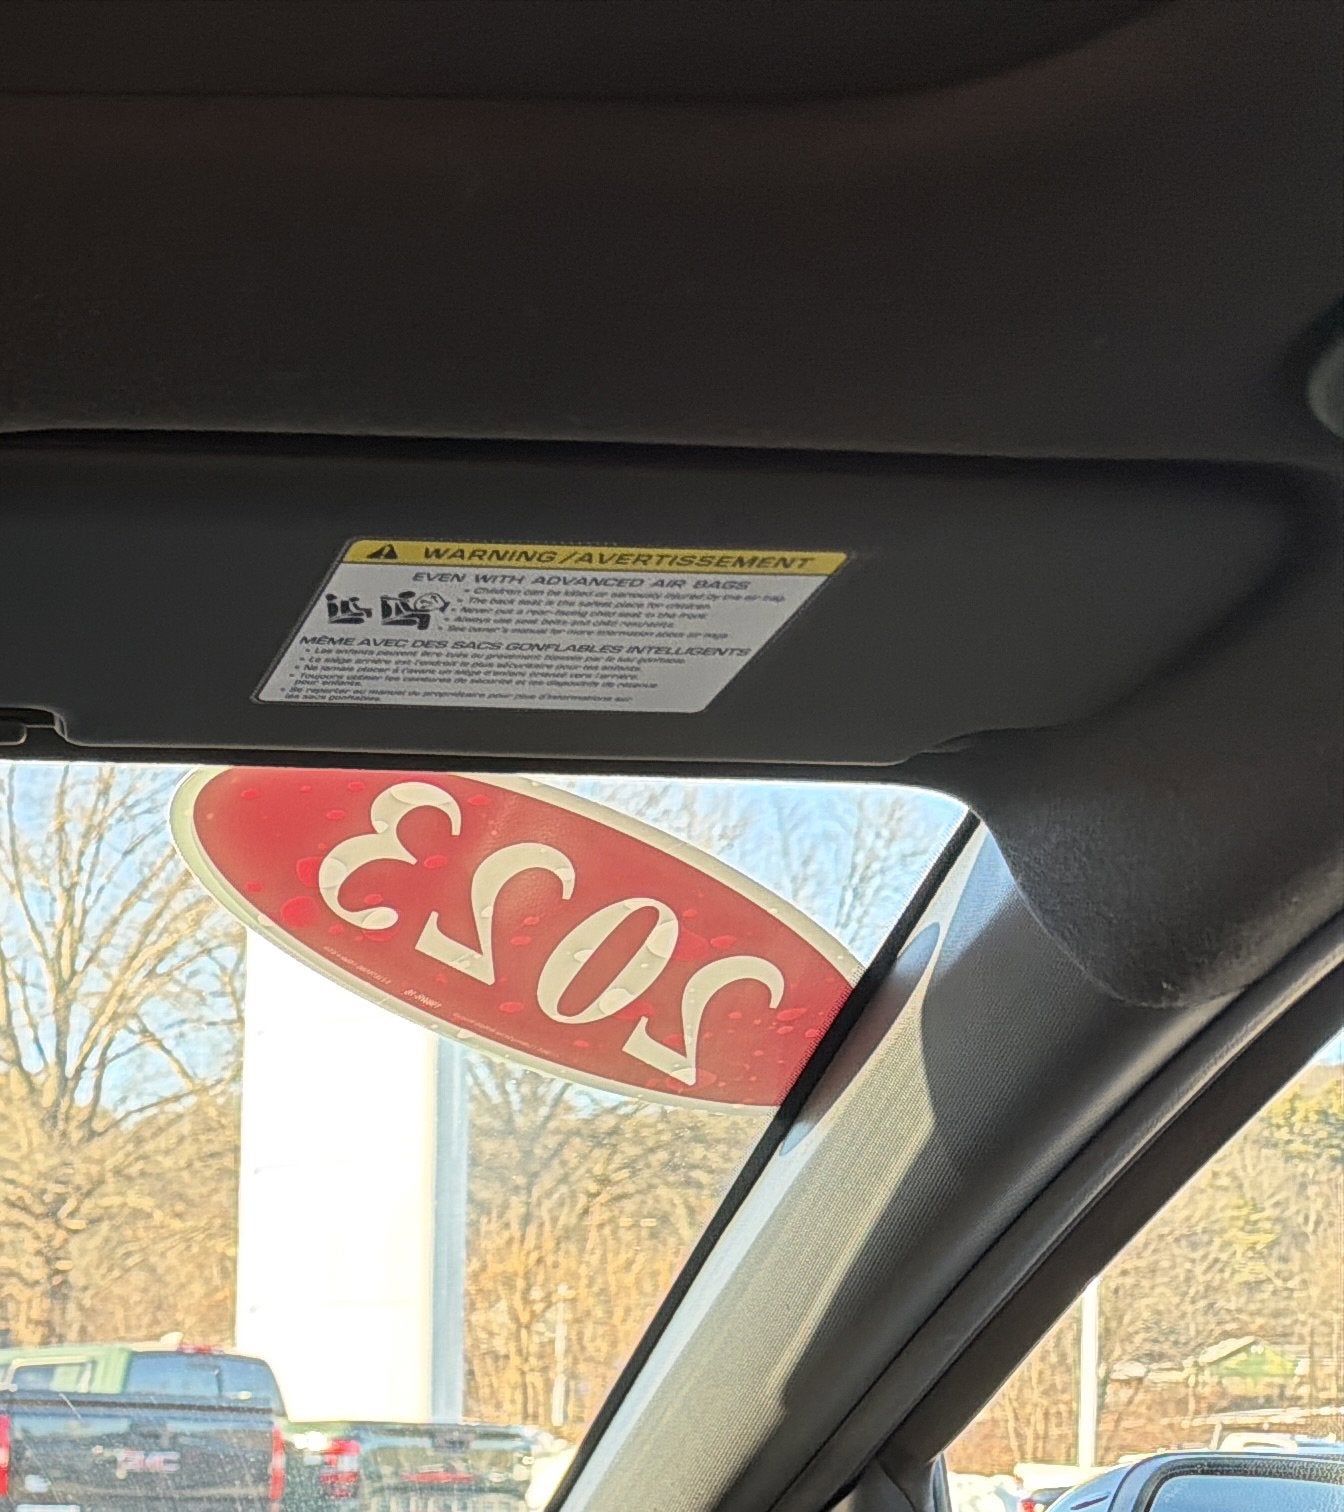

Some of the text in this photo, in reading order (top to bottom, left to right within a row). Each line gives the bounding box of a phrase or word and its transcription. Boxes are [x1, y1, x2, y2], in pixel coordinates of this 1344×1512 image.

[423, 546, 558, 563] WARNING
[574, 550, 816, 569] AVERTISSEMENT
[412, 571, 752, 590] EVEN WITH ADVANCED AIR BAGS
[299, 634, 752, 656] MÊME AVEC DES SACS GONFLABLES INTELLIGENTS
